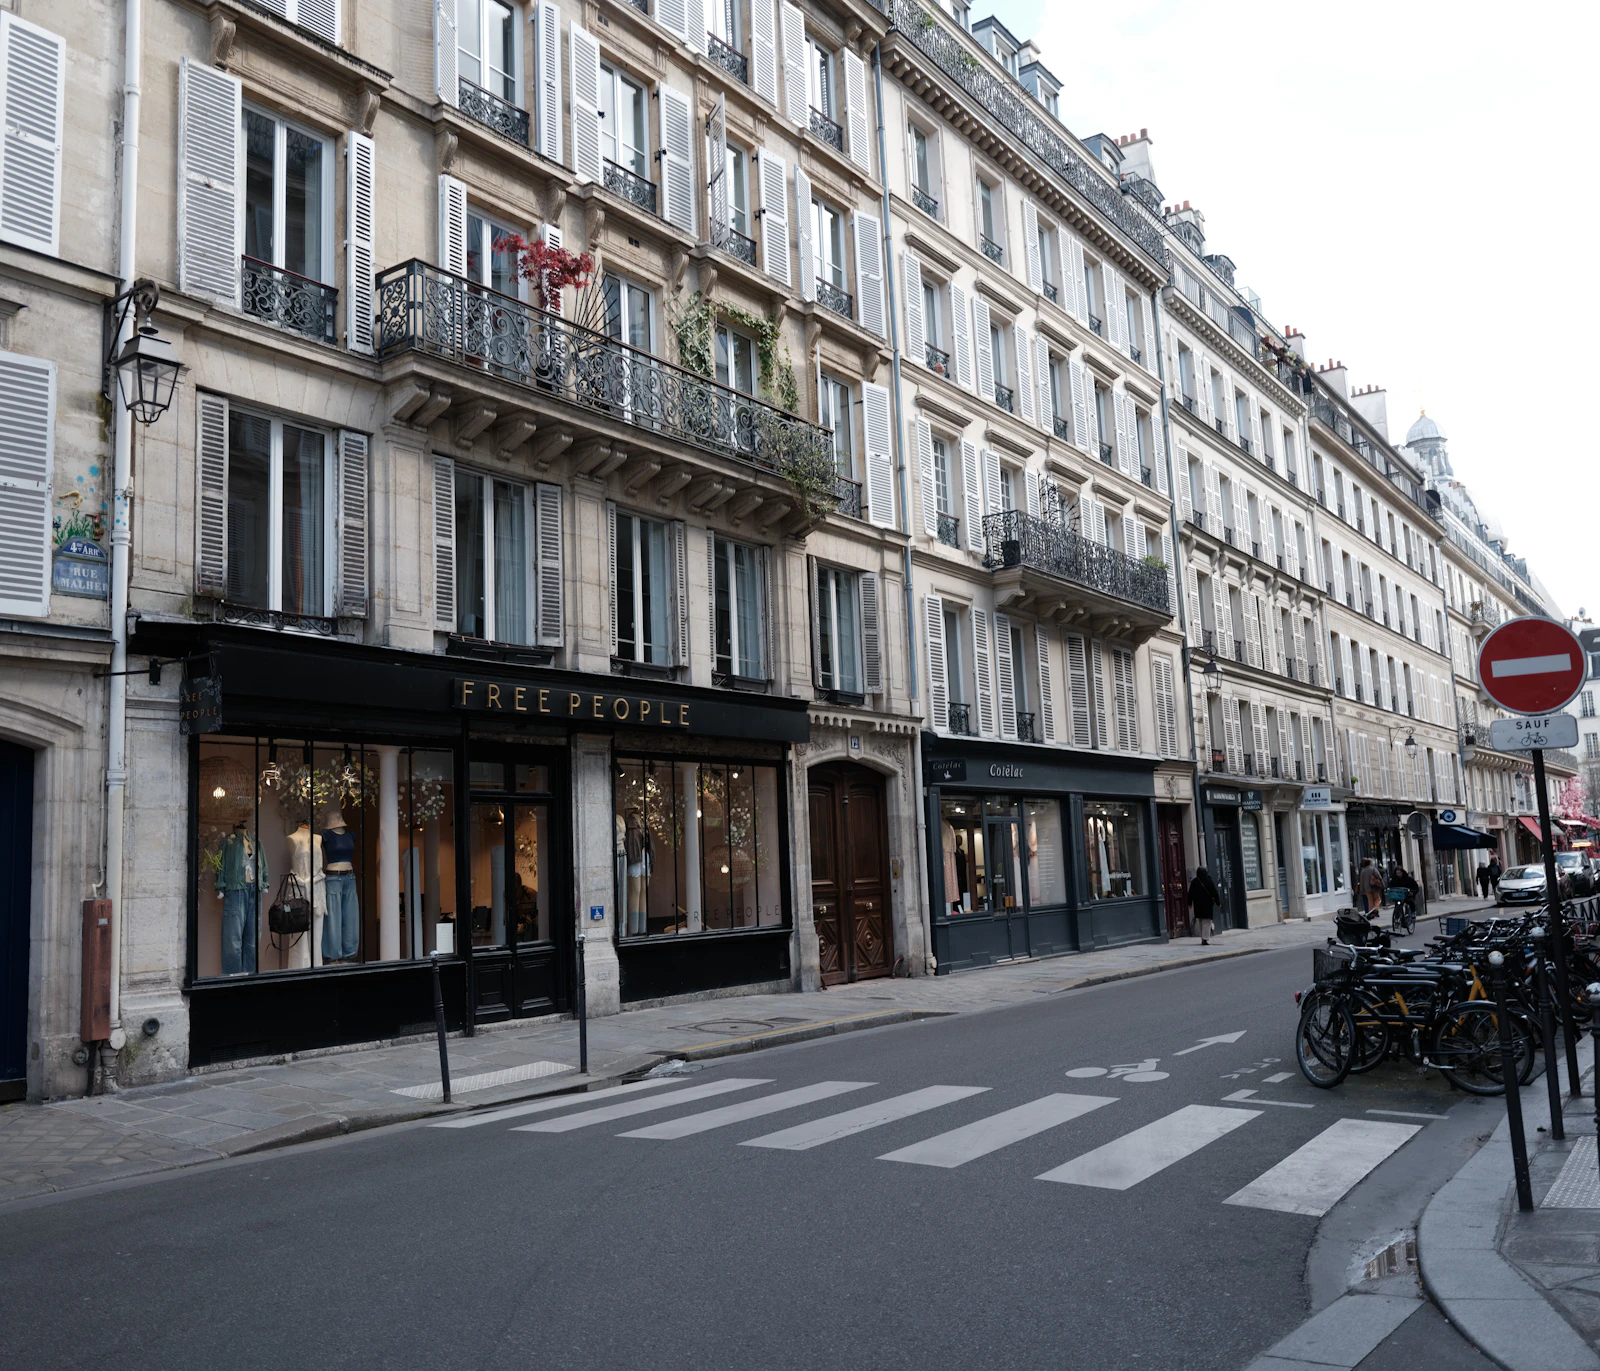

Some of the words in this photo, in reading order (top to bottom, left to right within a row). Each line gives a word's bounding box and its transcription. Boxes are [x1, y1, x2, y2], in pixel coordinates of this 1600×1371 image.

[73, 567, 98, 579] RUE
[180, 691, 204, 704] FREE
[461, 681, 551, 713] FREE
[568, 692, 690, 726] PEOPLE
[180, 706, 217, 720] PEOPLE
[1516, 719, 1550, 730] SAUF
[932, 760, 962, 770] Cotélac
[989, 763, 1024, 778] Cotélac
